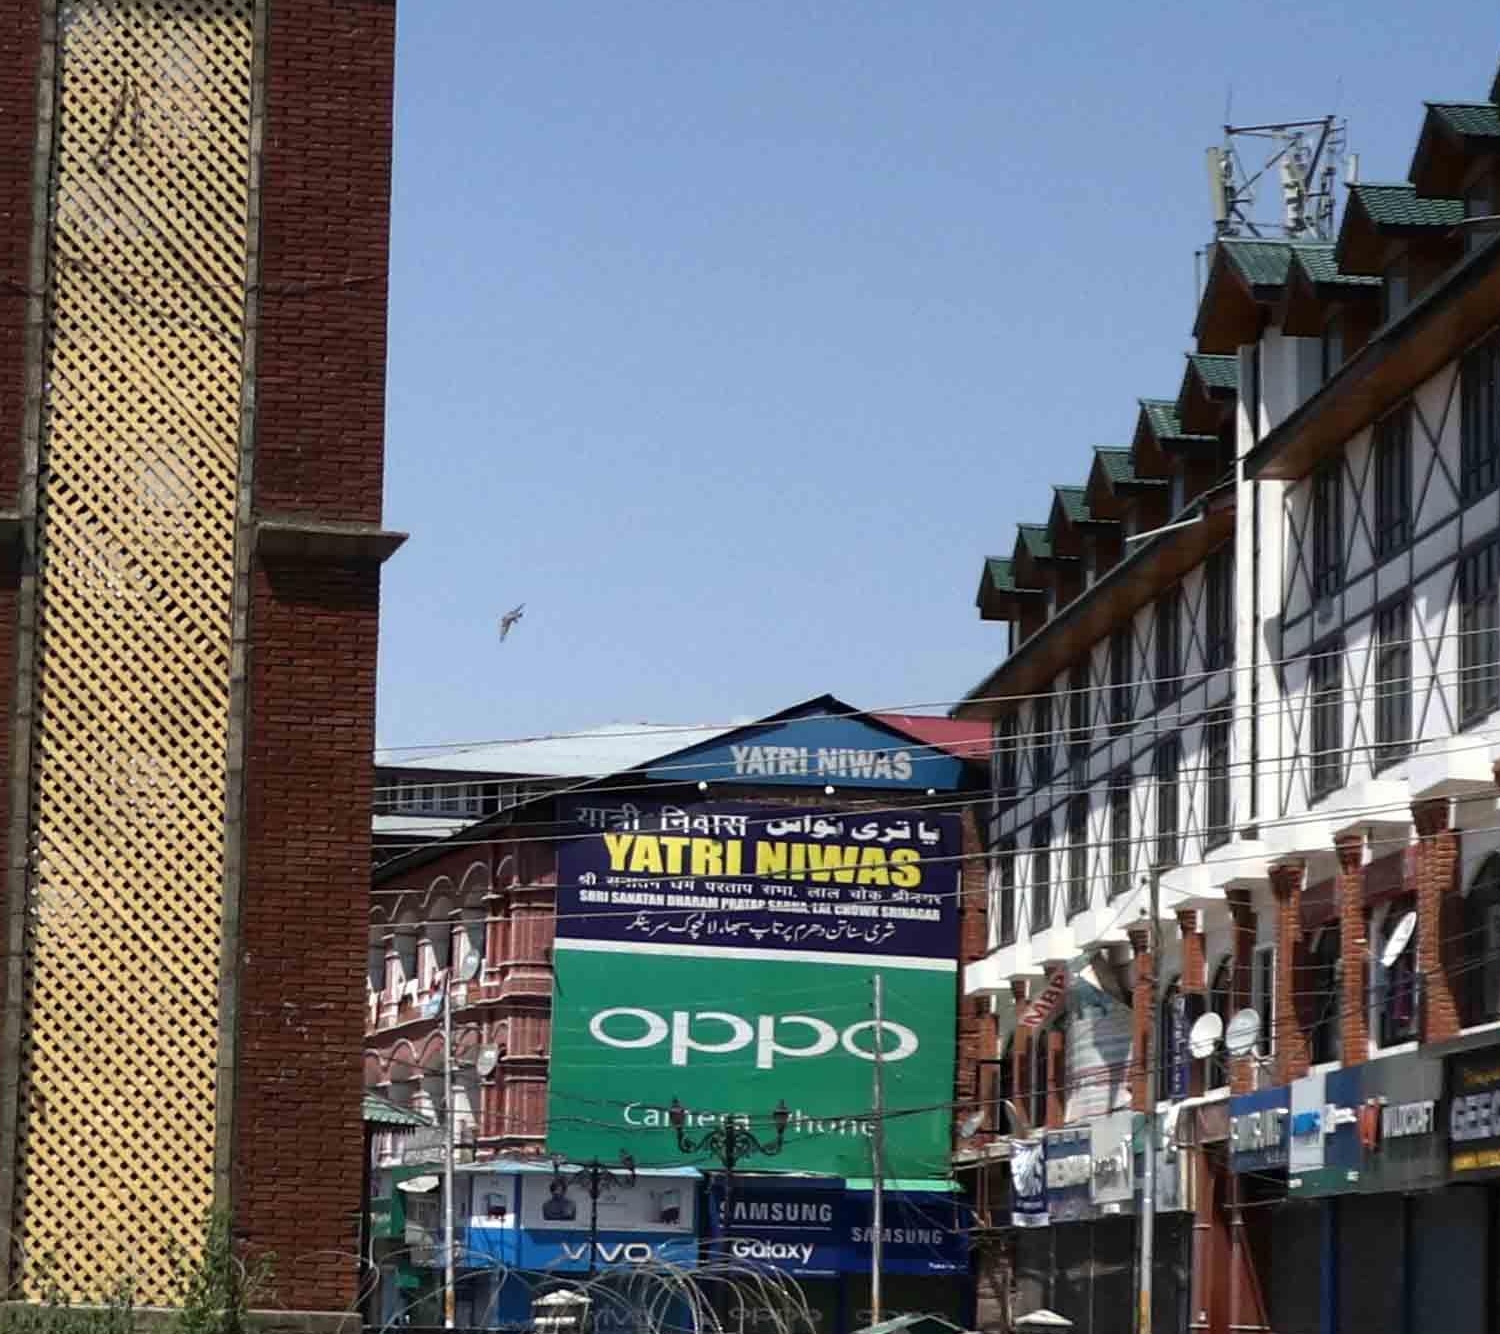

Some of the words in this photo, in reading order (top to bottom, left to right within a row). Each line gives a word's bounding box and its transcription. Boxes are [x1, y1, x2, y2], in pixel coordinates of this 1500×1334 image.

[731, 746, 808, 776] YATRI
[817, 746, 913, 781] NIWAS
[661, 804, 748, 836] निवास
[603, 832, 741, 876] YATRI
[756, 840, 922, 886] NIWAS
[579, 889, 609, 903] SHRI
[611, 891, 665, 907] SANATAN
[667, 894, 719, 910] DHARAM
[721, 897, 766, 911] PRATAP
[812, 902, 832, 915] LAL
[808, 886, 840, 899] लाल
[589, 1007, 919, 1069] oppo
[780, 1109, 877, 1138] hone
[732, 1240, 815, 1264] Galaxy
